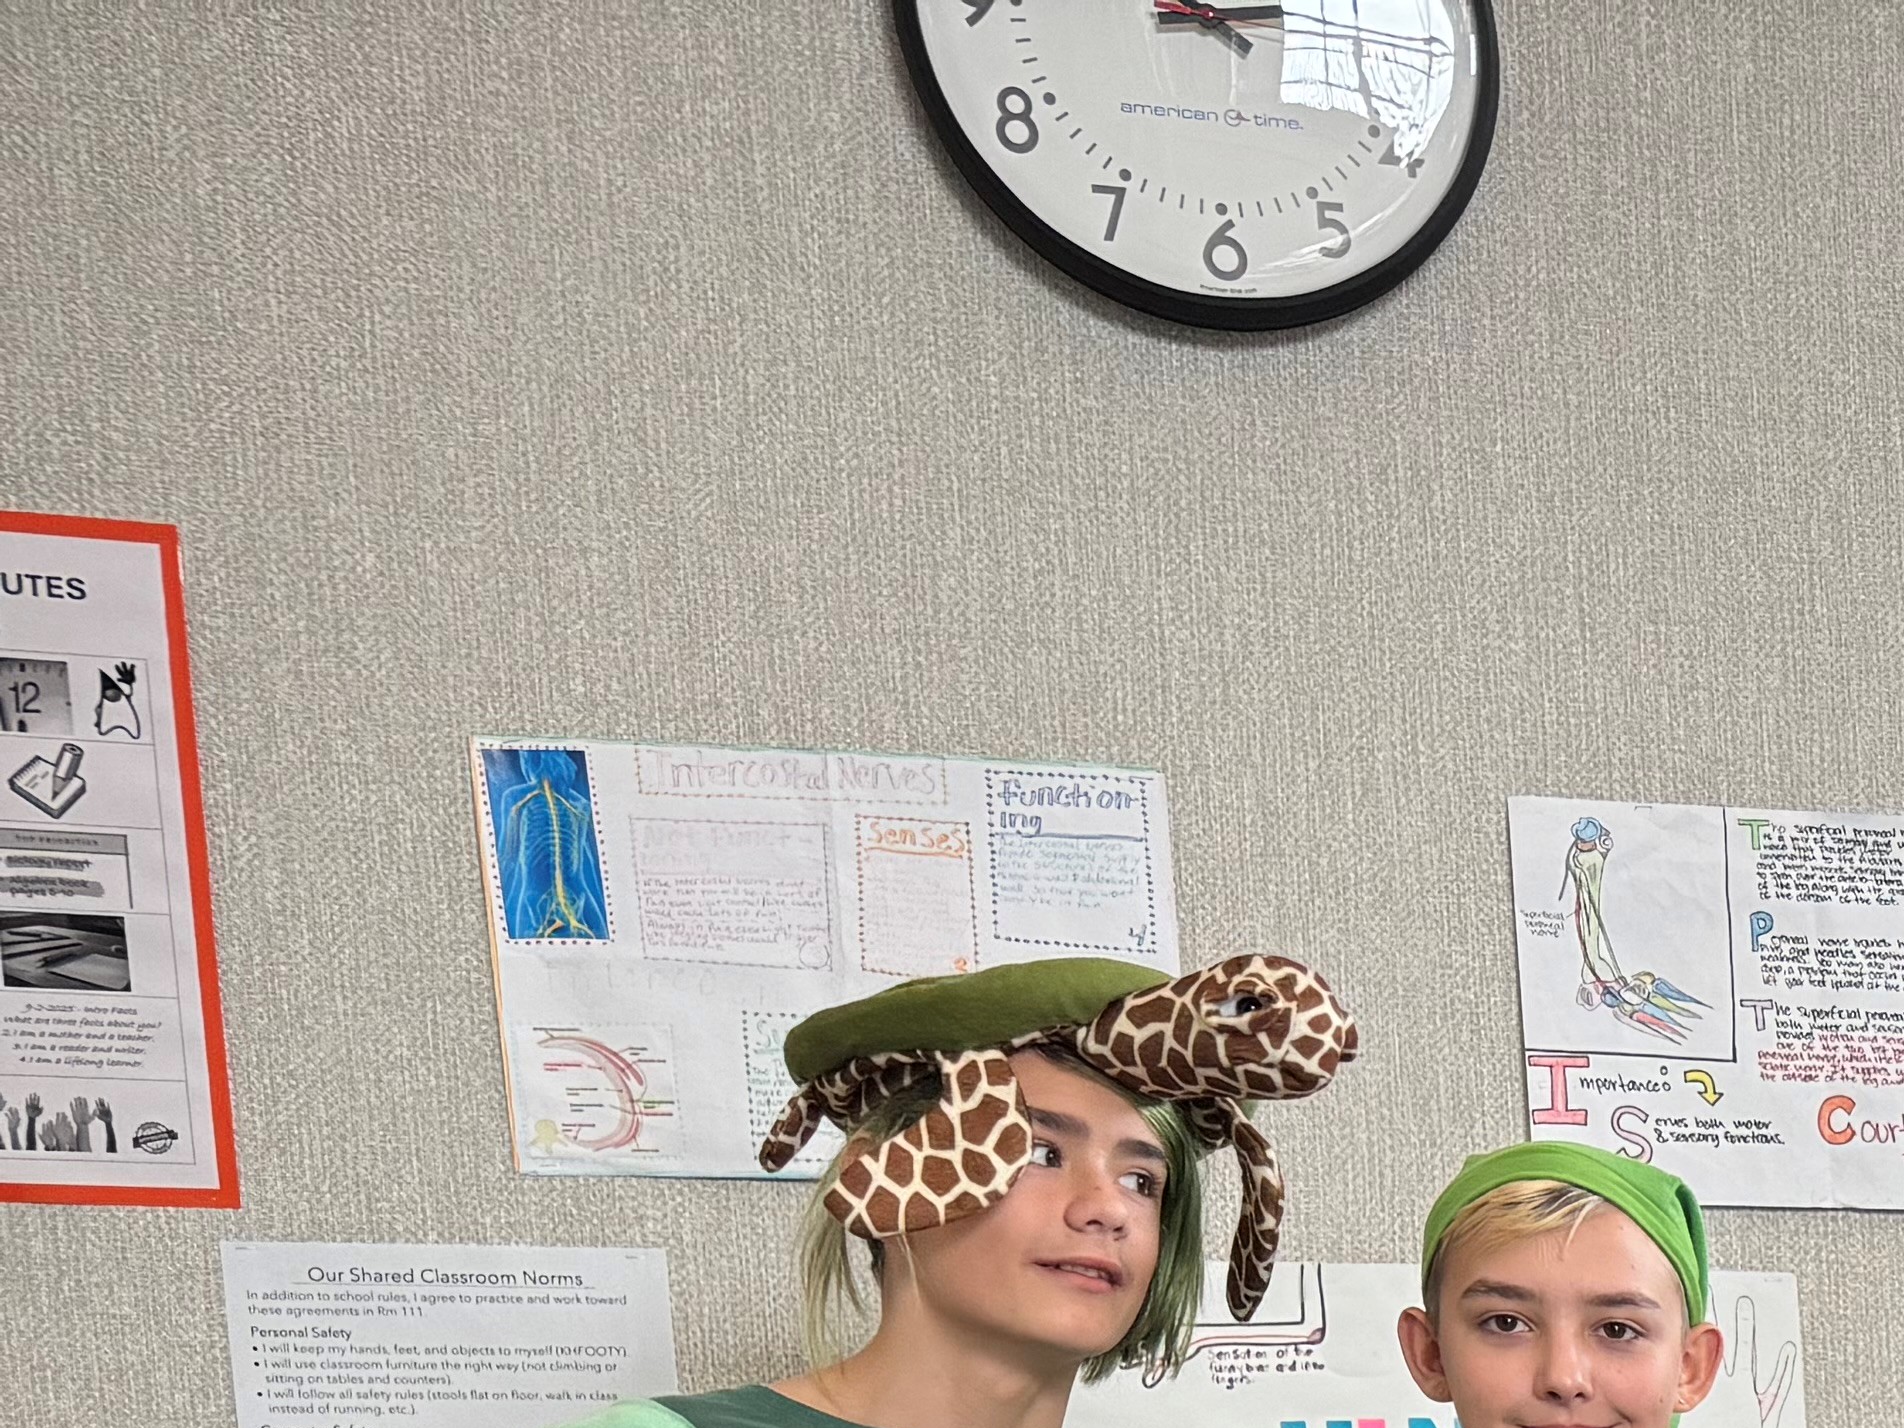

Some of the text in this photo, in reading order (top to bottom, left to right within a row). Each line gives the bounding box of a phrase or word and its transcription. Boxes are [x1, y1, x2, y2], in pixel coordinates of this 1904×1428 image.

[996, 86, 1039, 154] 8
[1120, 102, 1218, 122] american
[1091, 185, 1126, 242] 7
[1316, 201, 1351, 259] 5
[1203, 219, 1248, 281] 6
[8, 681, 42, 713] 12
[837, 756, 936, 794] Nerves
[1695, 1117, 1725, 1129] both
[307, 1267, 583, 1286] Our Shared Classroom Norms
[250, 1326, 352, 1342] Personal Safety
